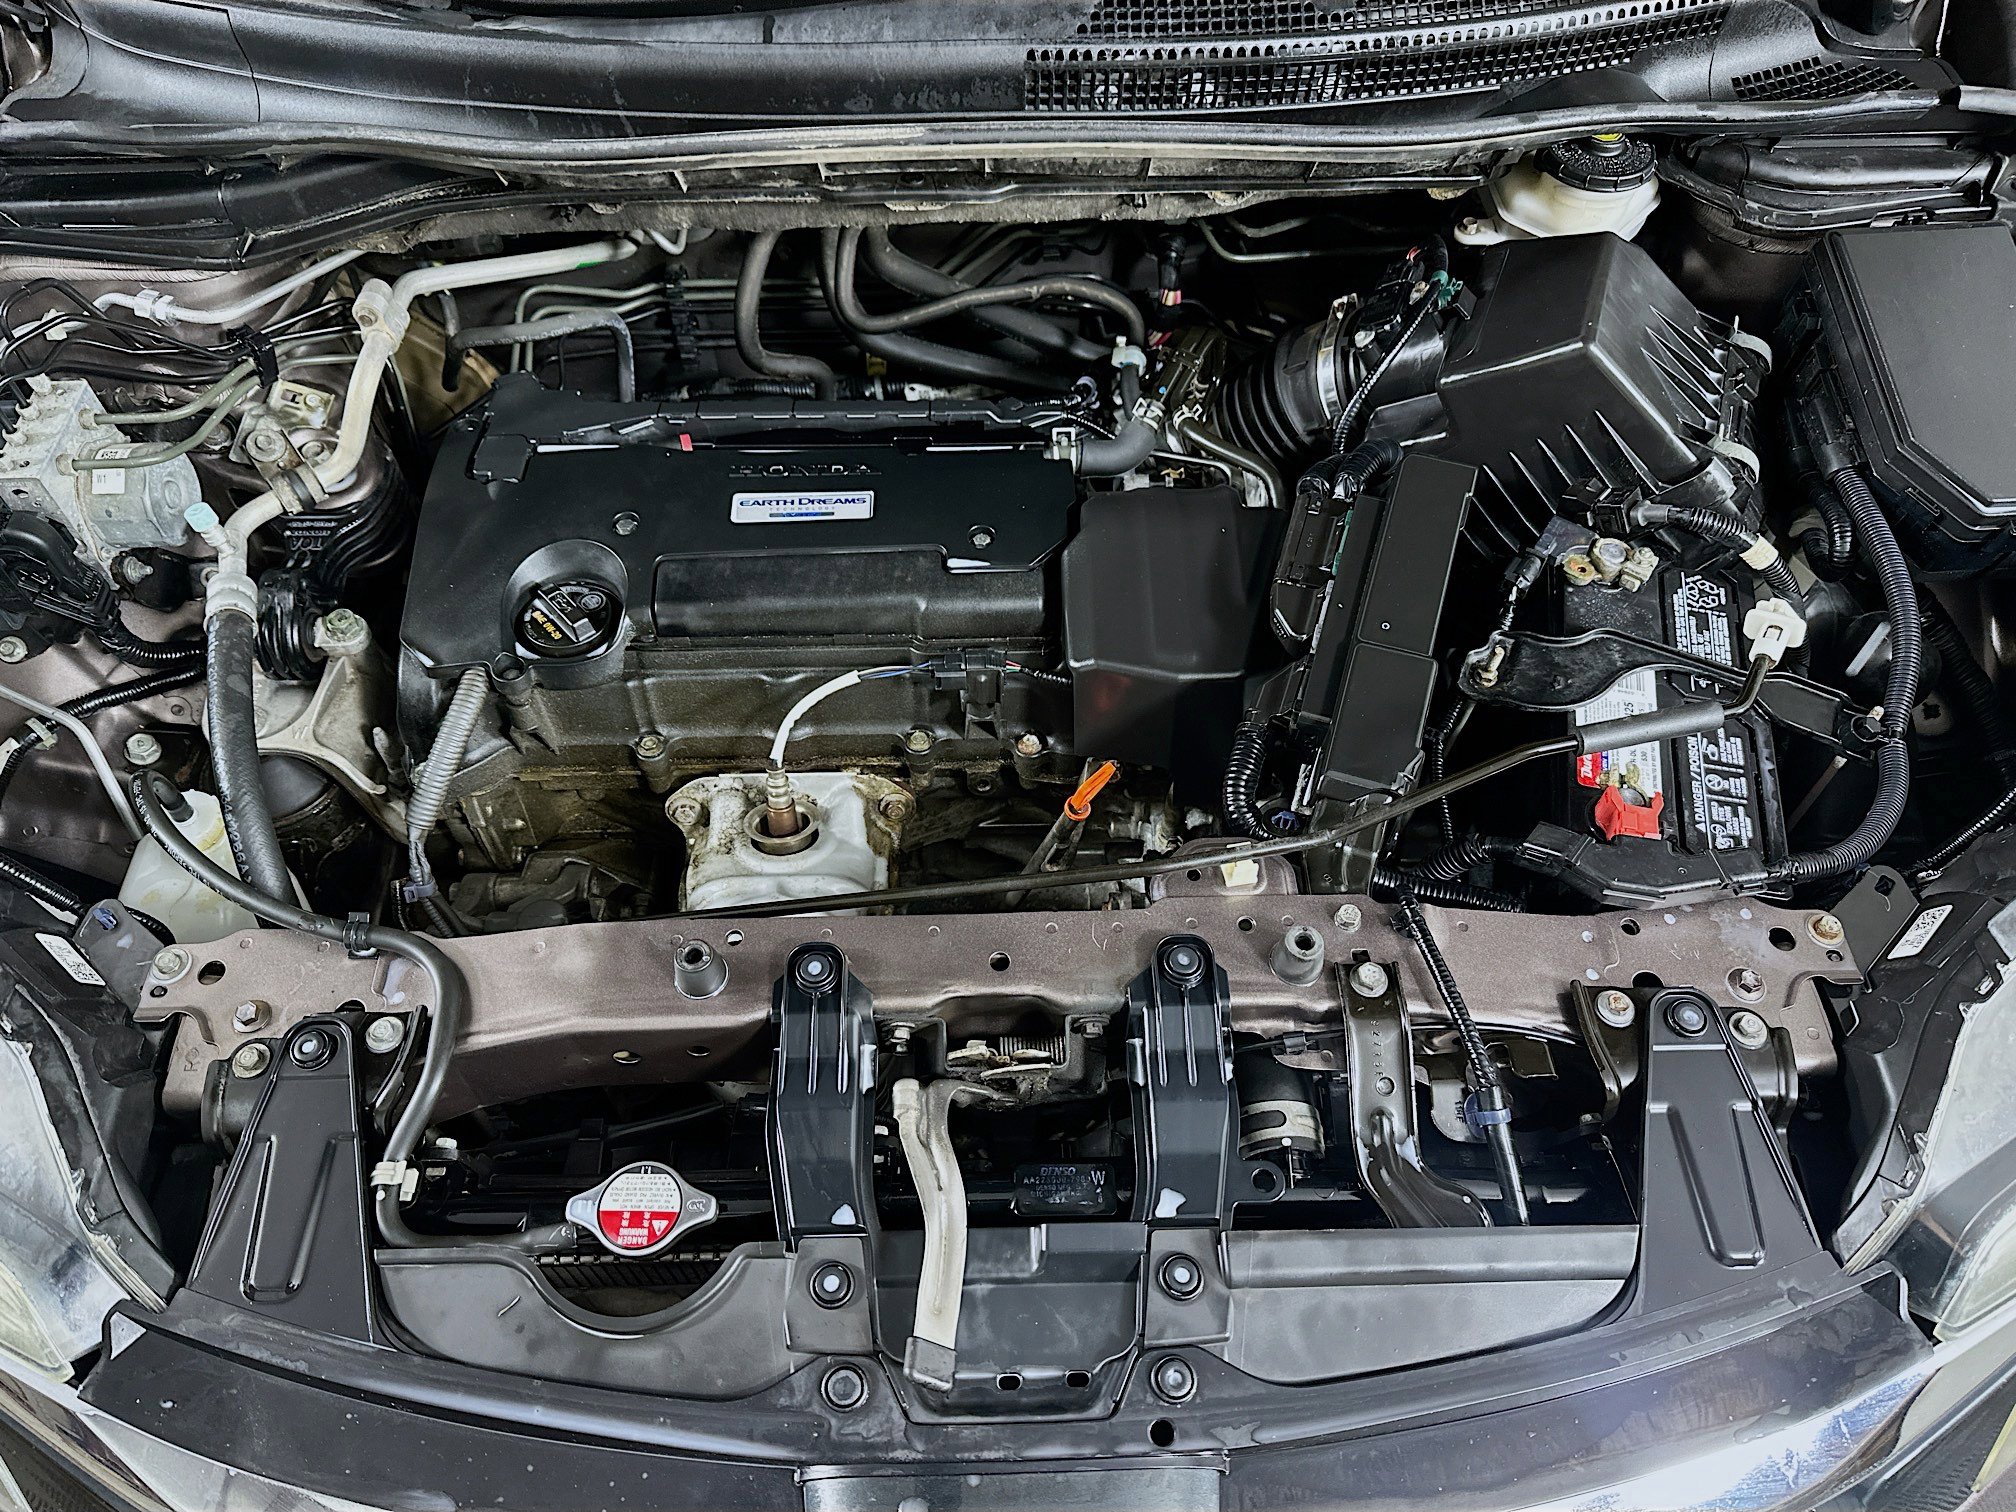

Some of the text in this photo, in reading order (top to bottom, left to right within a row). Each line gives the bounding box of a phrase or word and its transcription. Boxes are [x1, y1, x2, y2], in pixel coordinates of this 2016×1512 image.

[739, 497, 867, 507] EARTH DREAMS
[1687, 736, 1701, 773] POISON
[1691, 781, 1706, 821] DANGER
[618, 1235, 648, 1245] DANGER
